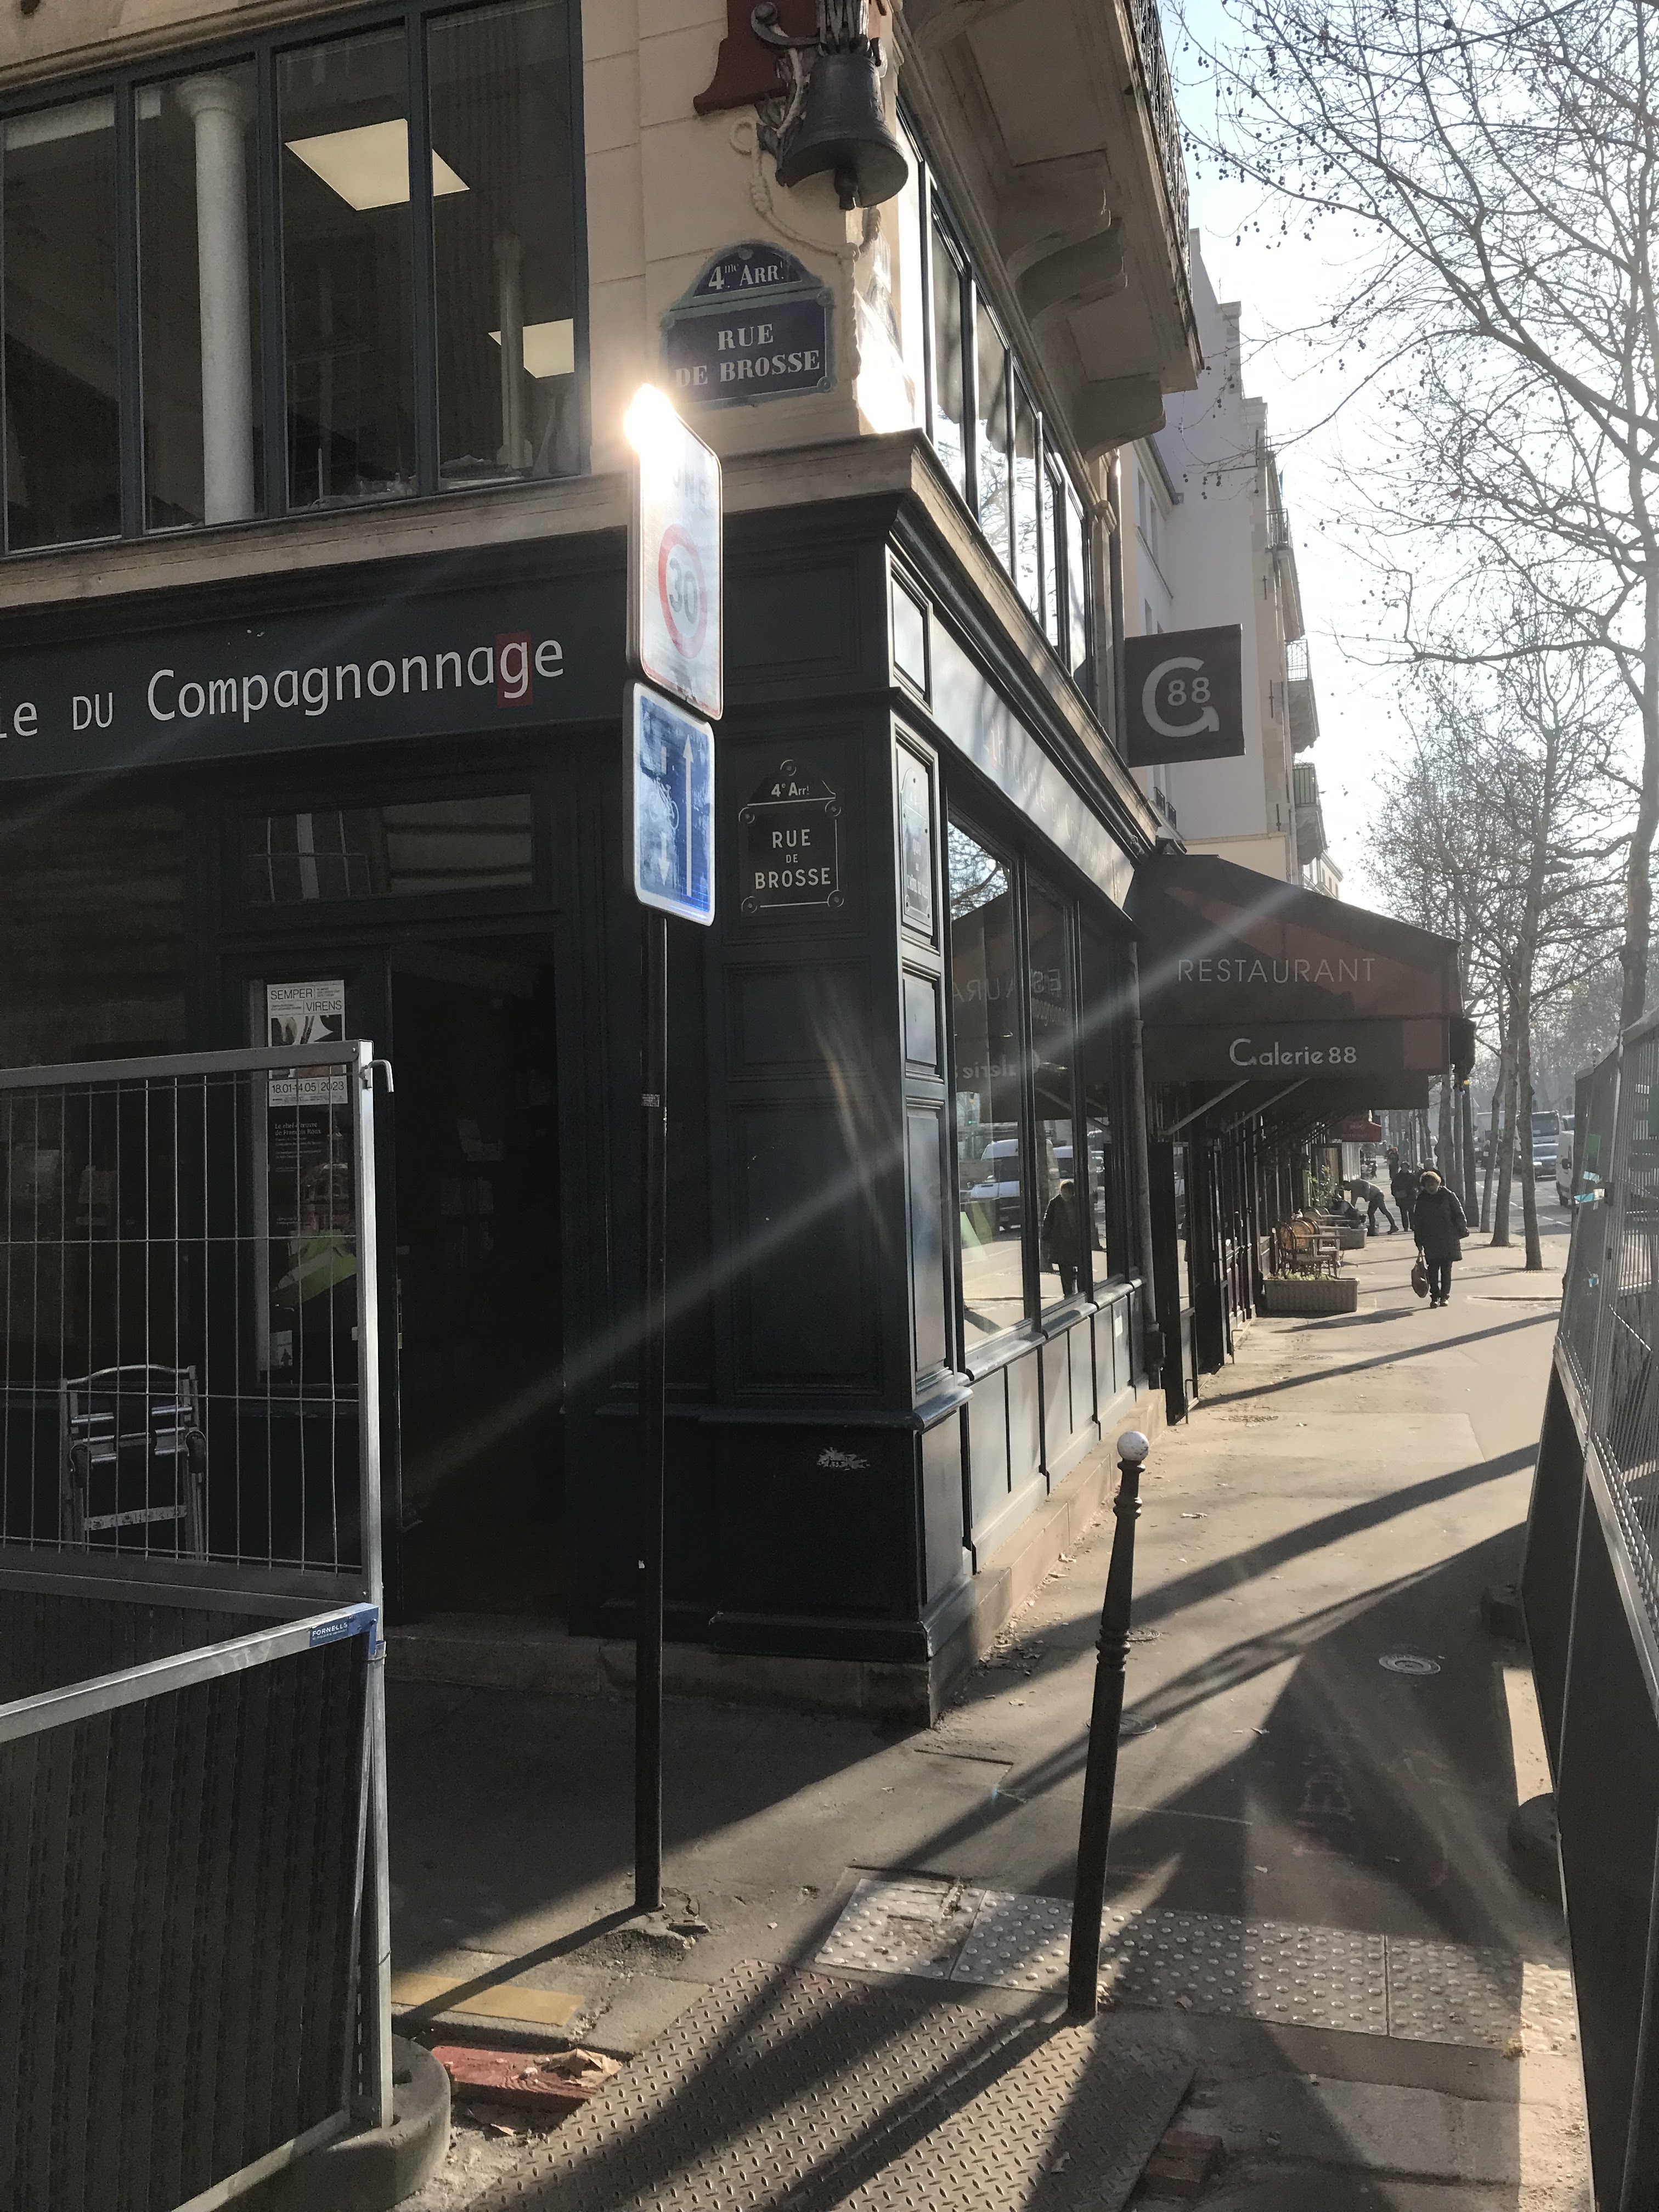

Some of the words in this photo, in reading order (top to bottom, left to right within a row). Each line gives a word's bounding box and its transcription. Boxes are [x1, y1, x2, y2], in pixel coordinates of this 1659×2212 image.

[718, 323, 774, 351] RUE
[675, 365, 708, 387] DE
[720, 349, 820, 383] BROSSE
[669, 557, 699, 624] 30
[72, 692, 114, 731] DU
[146, 637, 565, 723] Compagnonnage
[1167, 676, 1211, 707] 88
[772, 829, 811, 849] RUE
[786, 854, 799, 864] DE
[755, 867, 832, 890] BROSSE
[1177, 957, 1376, 984] RESTAURANT
[270, 988, 313, 1000] SEMPER
[306, 1000, 342, 1012] VIRENS
[1229, 1037, 1324, 1066] Galerie
[1328, 1046, 1357, 1064] 88
[312, 1622, 348, 1637] FORNELLS
